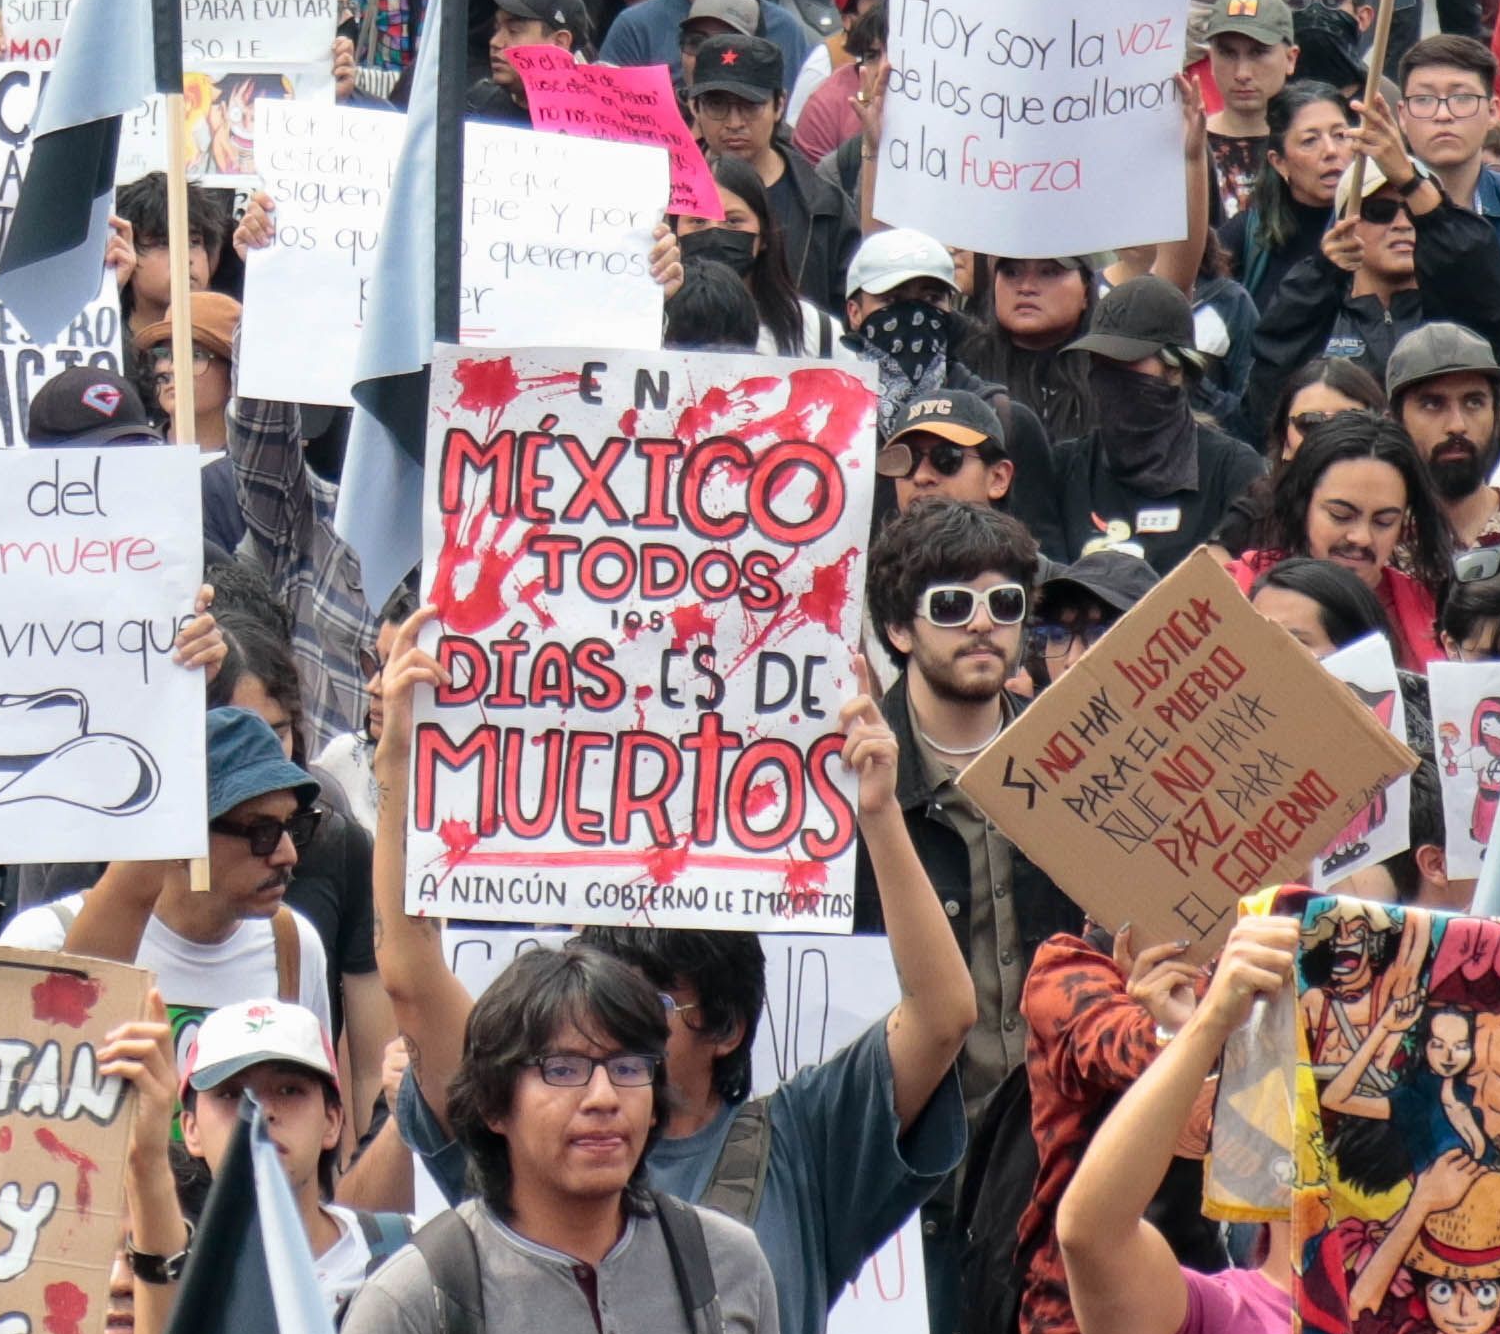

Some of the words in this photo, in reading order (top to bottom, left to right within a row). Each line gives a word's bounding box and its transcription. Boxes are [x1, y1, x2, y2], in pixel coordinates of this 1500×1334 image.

[185, 0, 245, 20] PARA
[1071, 18, 1105, 69] la
[237, 40, 264, 59] LE
[888, 49, 922, 102] de
[930, 58, 971, 117] los
[979, 91, 1046, 140] que
[1052, 76, 1179, 126] callaron
[960, 134, 1082, 193] fuerza
[578, 360, 671, 411] EN
[26, 455, 109, 519] del
[436, 413, 847, 547] MÉXICO
[527, 535, 785, 613] TODOS
[434, 621, 627, 713] DÍAS
[659, 644, 726, 712] ES
[754, 650, 828, 719] DE
[1113, 595, 1227, 710] JUSTICIA
[1001, 755, 1049, 811] SI
[1035, 729, 1087, 785] NO
[1069, 685, 1125, 749] HAY
[1061, 753, 1134, 824] PARA
[1154, 644, 1249, 734] PUEBLO
[413, 711, 859, 862] MUERTOS
[1150, 743, 1218, 808] NO
[1211, 768, 1340, 898] GOBIERNO
[418, 873, 438, 902] A
[450, 870, 568, 907] NINGÚN
[584, 882, 709, 913] GOBIERNO
[714, 890, 735, 914] LE
[740, 886, 854, 919] IMPORTAS
